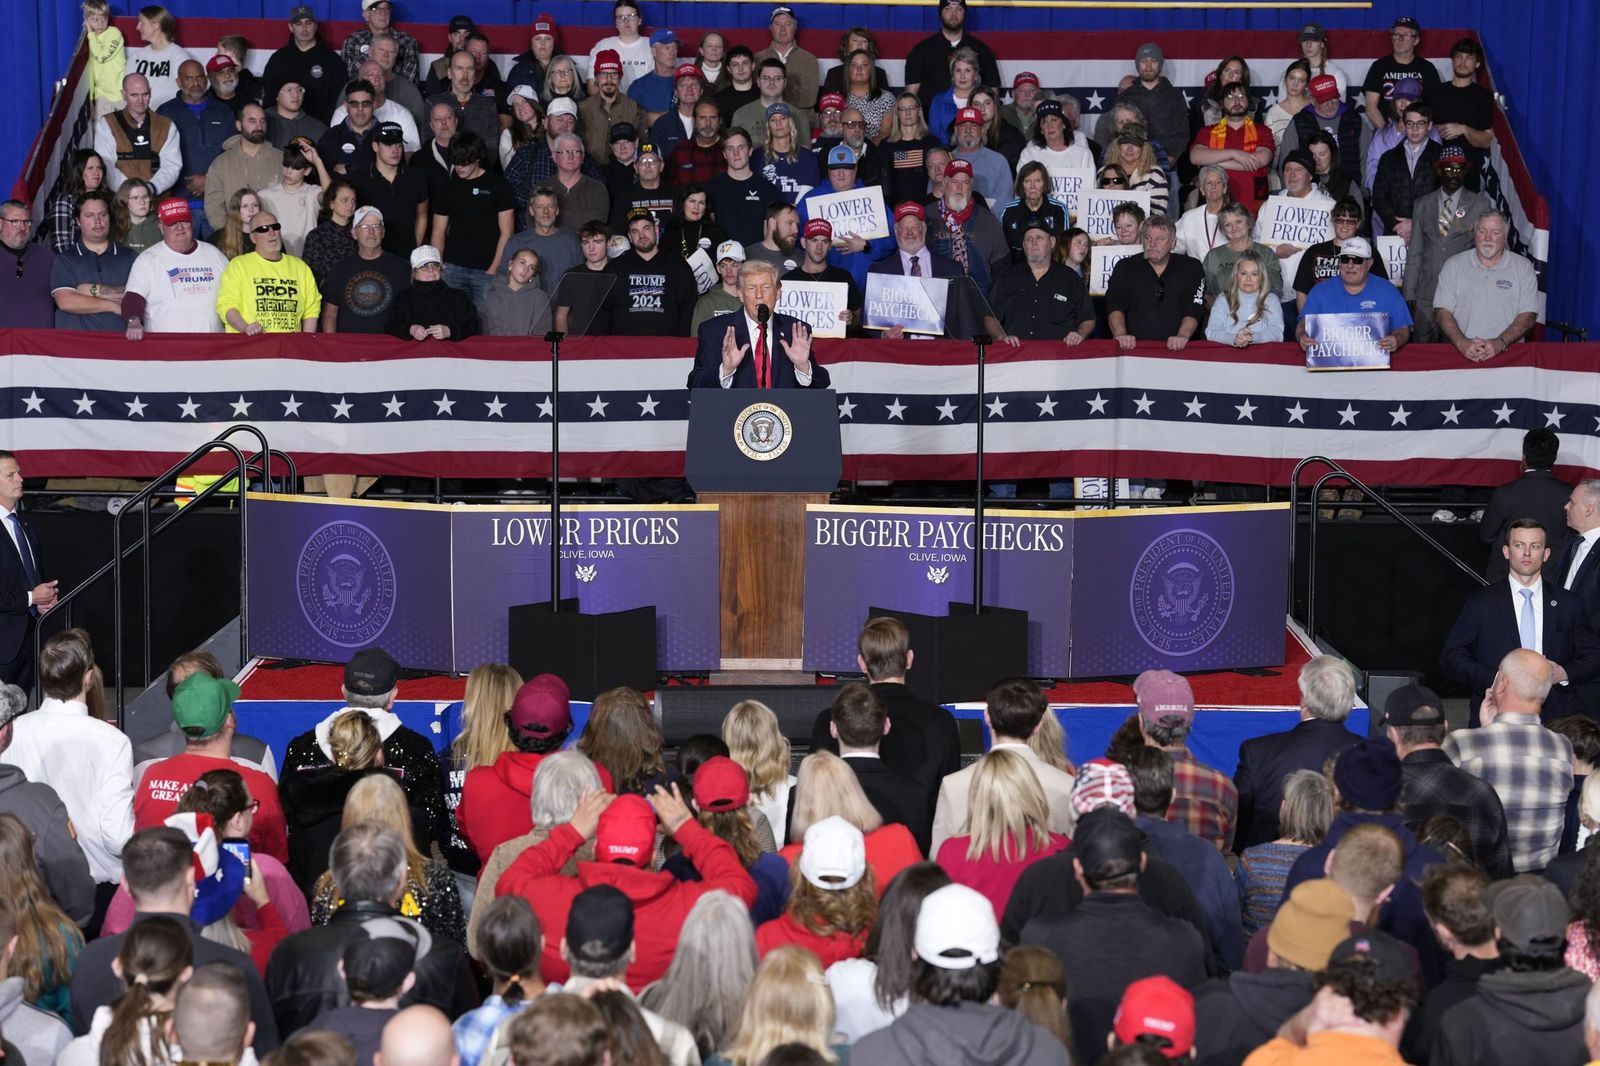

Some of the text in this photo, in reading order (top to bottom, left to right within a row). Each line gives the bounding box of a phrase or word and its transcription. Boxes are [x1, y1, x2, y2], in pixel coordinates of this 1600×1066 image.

[136, 59, 171, 77] OWA
[818, 197, 875, 220] LOWER
[1275, 205, 1330, 227] LOWER
[832, 214, 877, 238] RICES
[1271, 223, 1327, 244] PRICES
[720, 243, 732, 254] 47
[256, 285, 298, 298] DROP
[630, 275, 665, 287] TRUMP
[257, 299, 298, 312] EVERYTHING
[632, 295, 661, 308] 2024
[778, 290, 835, 309] LOWER
[1323, 326, 1372, 342] BIGGER
[588, 517, 680, 546] PRICES
[814, 517, 1065, 552] BIGGER PAYCHECKS
[299, 523, 345, 578] PRESIDENT
[588, 550, 615, 559] IOWA
[909, 552, 967, 562] CLIVE, IOWA
[371, 543, 394, 599] UNITED
[1133, 533, 1183, 592] PRESIDENT
[1209, 548, 1232, 601] UNITED
[313, 614, 340, 641] SEAL
[356, 604, 391, 642] STATES
[1191, 607, 1228, 650] STATES
[1147, 626, 1173, 651] SEAL
[149, 779, 180, 791] MAKE
[151, 789, 184, 803] GREA
[608, 844, 640, 855] TRUMP
